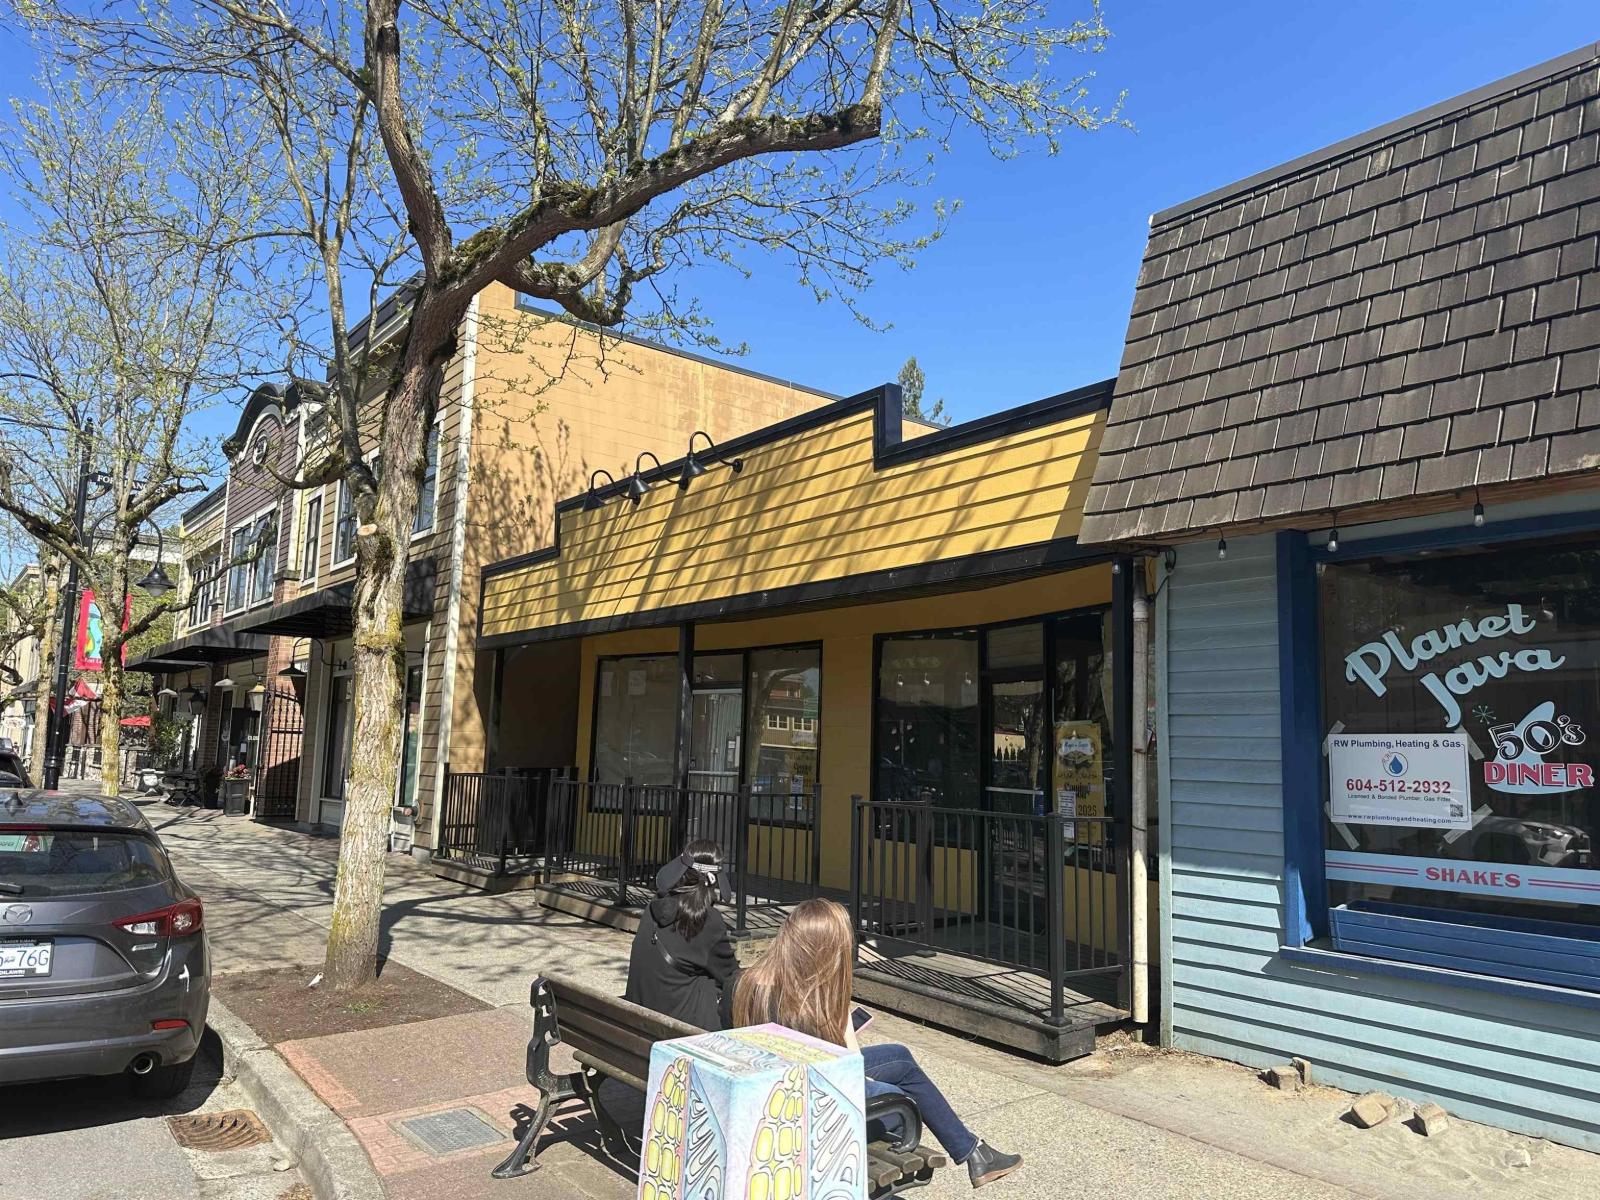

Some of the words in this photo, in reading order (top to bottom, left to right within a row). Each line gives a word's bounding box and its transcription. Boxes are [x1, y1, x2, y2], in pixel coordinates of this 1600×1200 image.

[1344, 603, 1536, 698] Planet
[1420, 649, 1566, 728] Java
[1333, 740, 1349, 748] RW
[1350, 740, 1395, 749] Plumbing,
[1395, 740, 1430, 749] Heating
[1442, 740, 1461, 748] Gas
[1487, 714, 1587, 761] 50's
[1346, 779, 1451, 794] 604-512-2932
[1483, 762, 1595, 788] DINER
[1347, 814, 1452, 824] www.rwplumbingandheating.com
[1425, 866, 1521, 889] SHAKES
